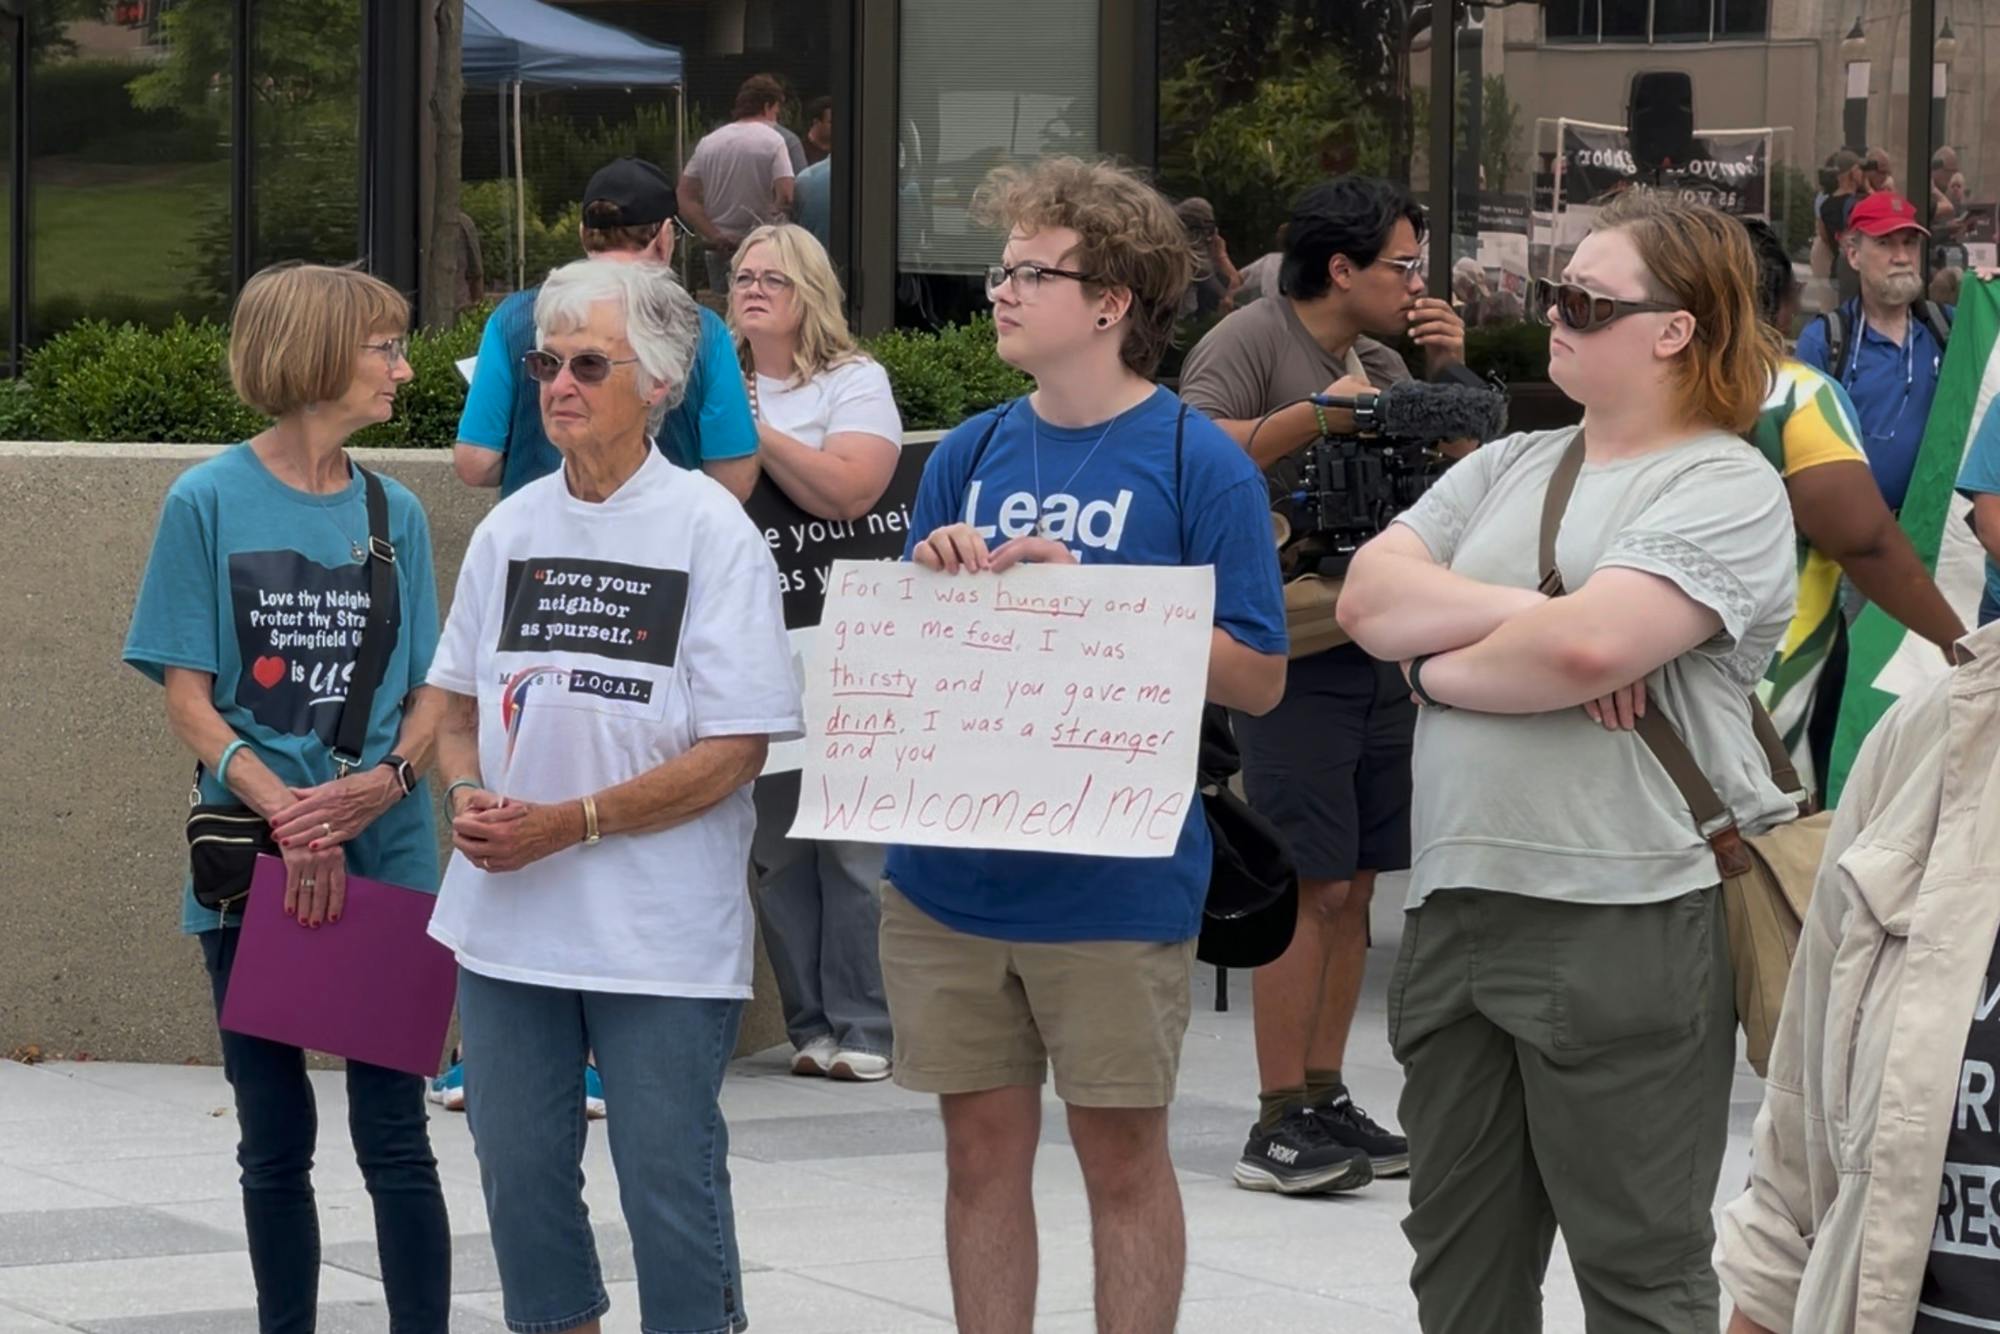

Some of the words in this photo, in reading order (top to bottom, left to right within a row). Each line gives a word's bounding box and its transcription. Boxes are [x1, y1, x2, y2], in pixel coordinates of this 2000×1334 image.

[965, 480, 1133, 551] Lead
[596, 576, 651, 595] your
[778, 569, 806, 593] as
[259, 589, 294, 606] Love
[298, 590, 321, 612] thy
[326, 590, 371, 609] Neighb
[537, 594, 630, 618] neighbor
[841, 570, 880, 597] For
[898, 577, 915, 600] I
[934, 588, 979, 603] was
[995, 580, 1091, 617] hungry
[1105, 598, 1147, 613] and
[1163, 604, 1197, 626] you
[250, 610, 303, 627] Protect
[307, 611, 331, 628] thy
[337, 610, 367, 627] Stra
[521, 623, 540, 636] as
[270, 629, 347, 649] Springfield
[835, 620, 896, 650] gave
[1039, 629, 1058, 651] I
[1081, 642, 1125, 660] was
[291, 660, 305, 682] is
[499, 672, 544, 686] Me
[574, 675, 650, 698] LOCAL.
[830, 657, 917, 697] thirsty
[935, 670, 984, 692] and
[1008, 681, 1045, 708] you
[1064, 682, 1126, 715] gave
[1137, 684, 1171, 704] me
[922, 710, 940, 731] I
[961, 717, 1004, 731] was
[1020, 723, 1034, 736] a
[1050, 717, 1175, 764] stranger
[826, 735, 876, 759] and
[895, 744, 936, 772] you
[822, 773, 1093, 836] Welcomed
[1266, 1141, 1299, 1165] HOKA
